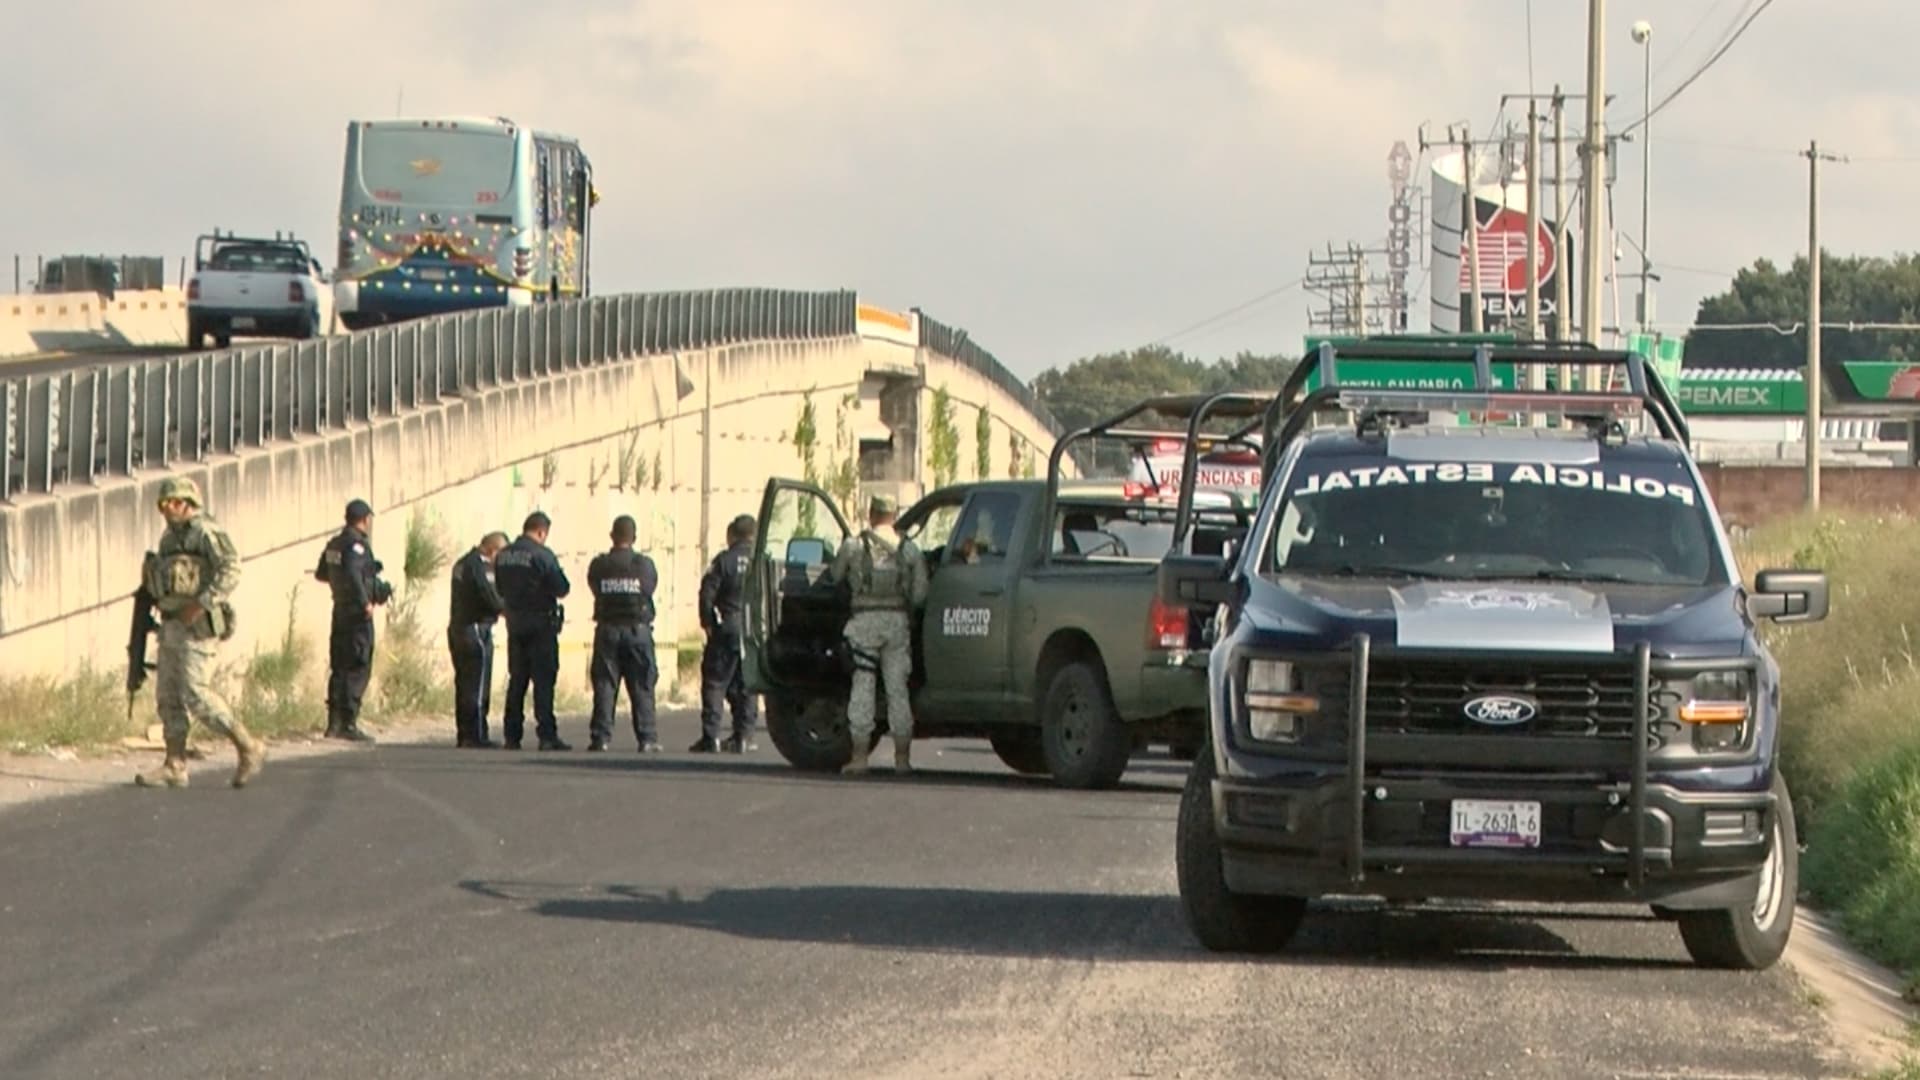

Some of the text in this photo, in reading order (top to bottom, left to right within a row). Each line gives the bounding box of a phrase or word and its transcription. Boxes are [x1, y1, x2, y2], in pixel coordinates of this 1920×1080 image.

[1679, 387, 1769, 404] PEMEX
[1160, 469, 1246, 485] URNCIAS
[1477, 700, 1522, 720] Ford
[1456, 811, 1537, 833] TL-263A-6
